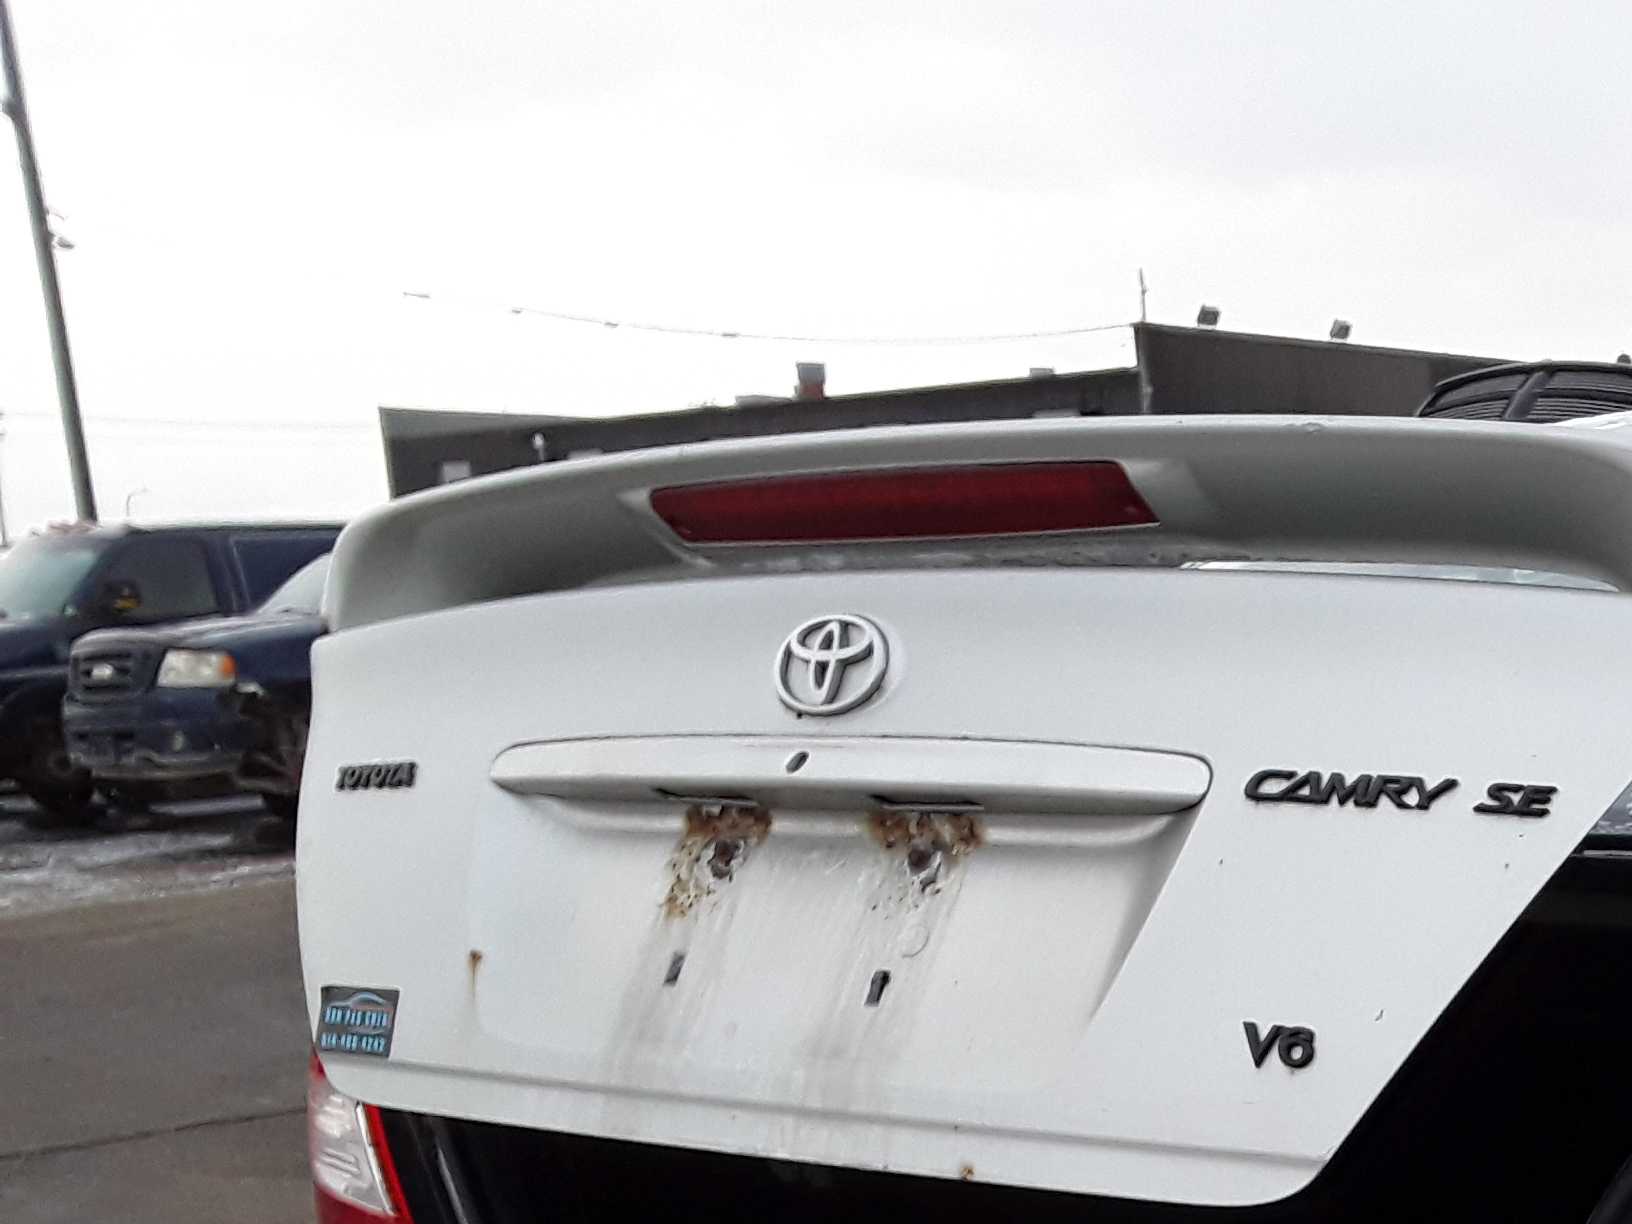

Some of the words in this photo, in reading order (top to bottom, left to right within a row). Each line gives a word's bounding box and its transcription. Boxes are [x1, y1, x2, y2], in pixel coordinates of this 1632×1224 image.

[1244, 768, 1459, 811] CAMRY
[1472, 782, 1559, 818] SE
[1243, 1020, 1316, 1069] V6
